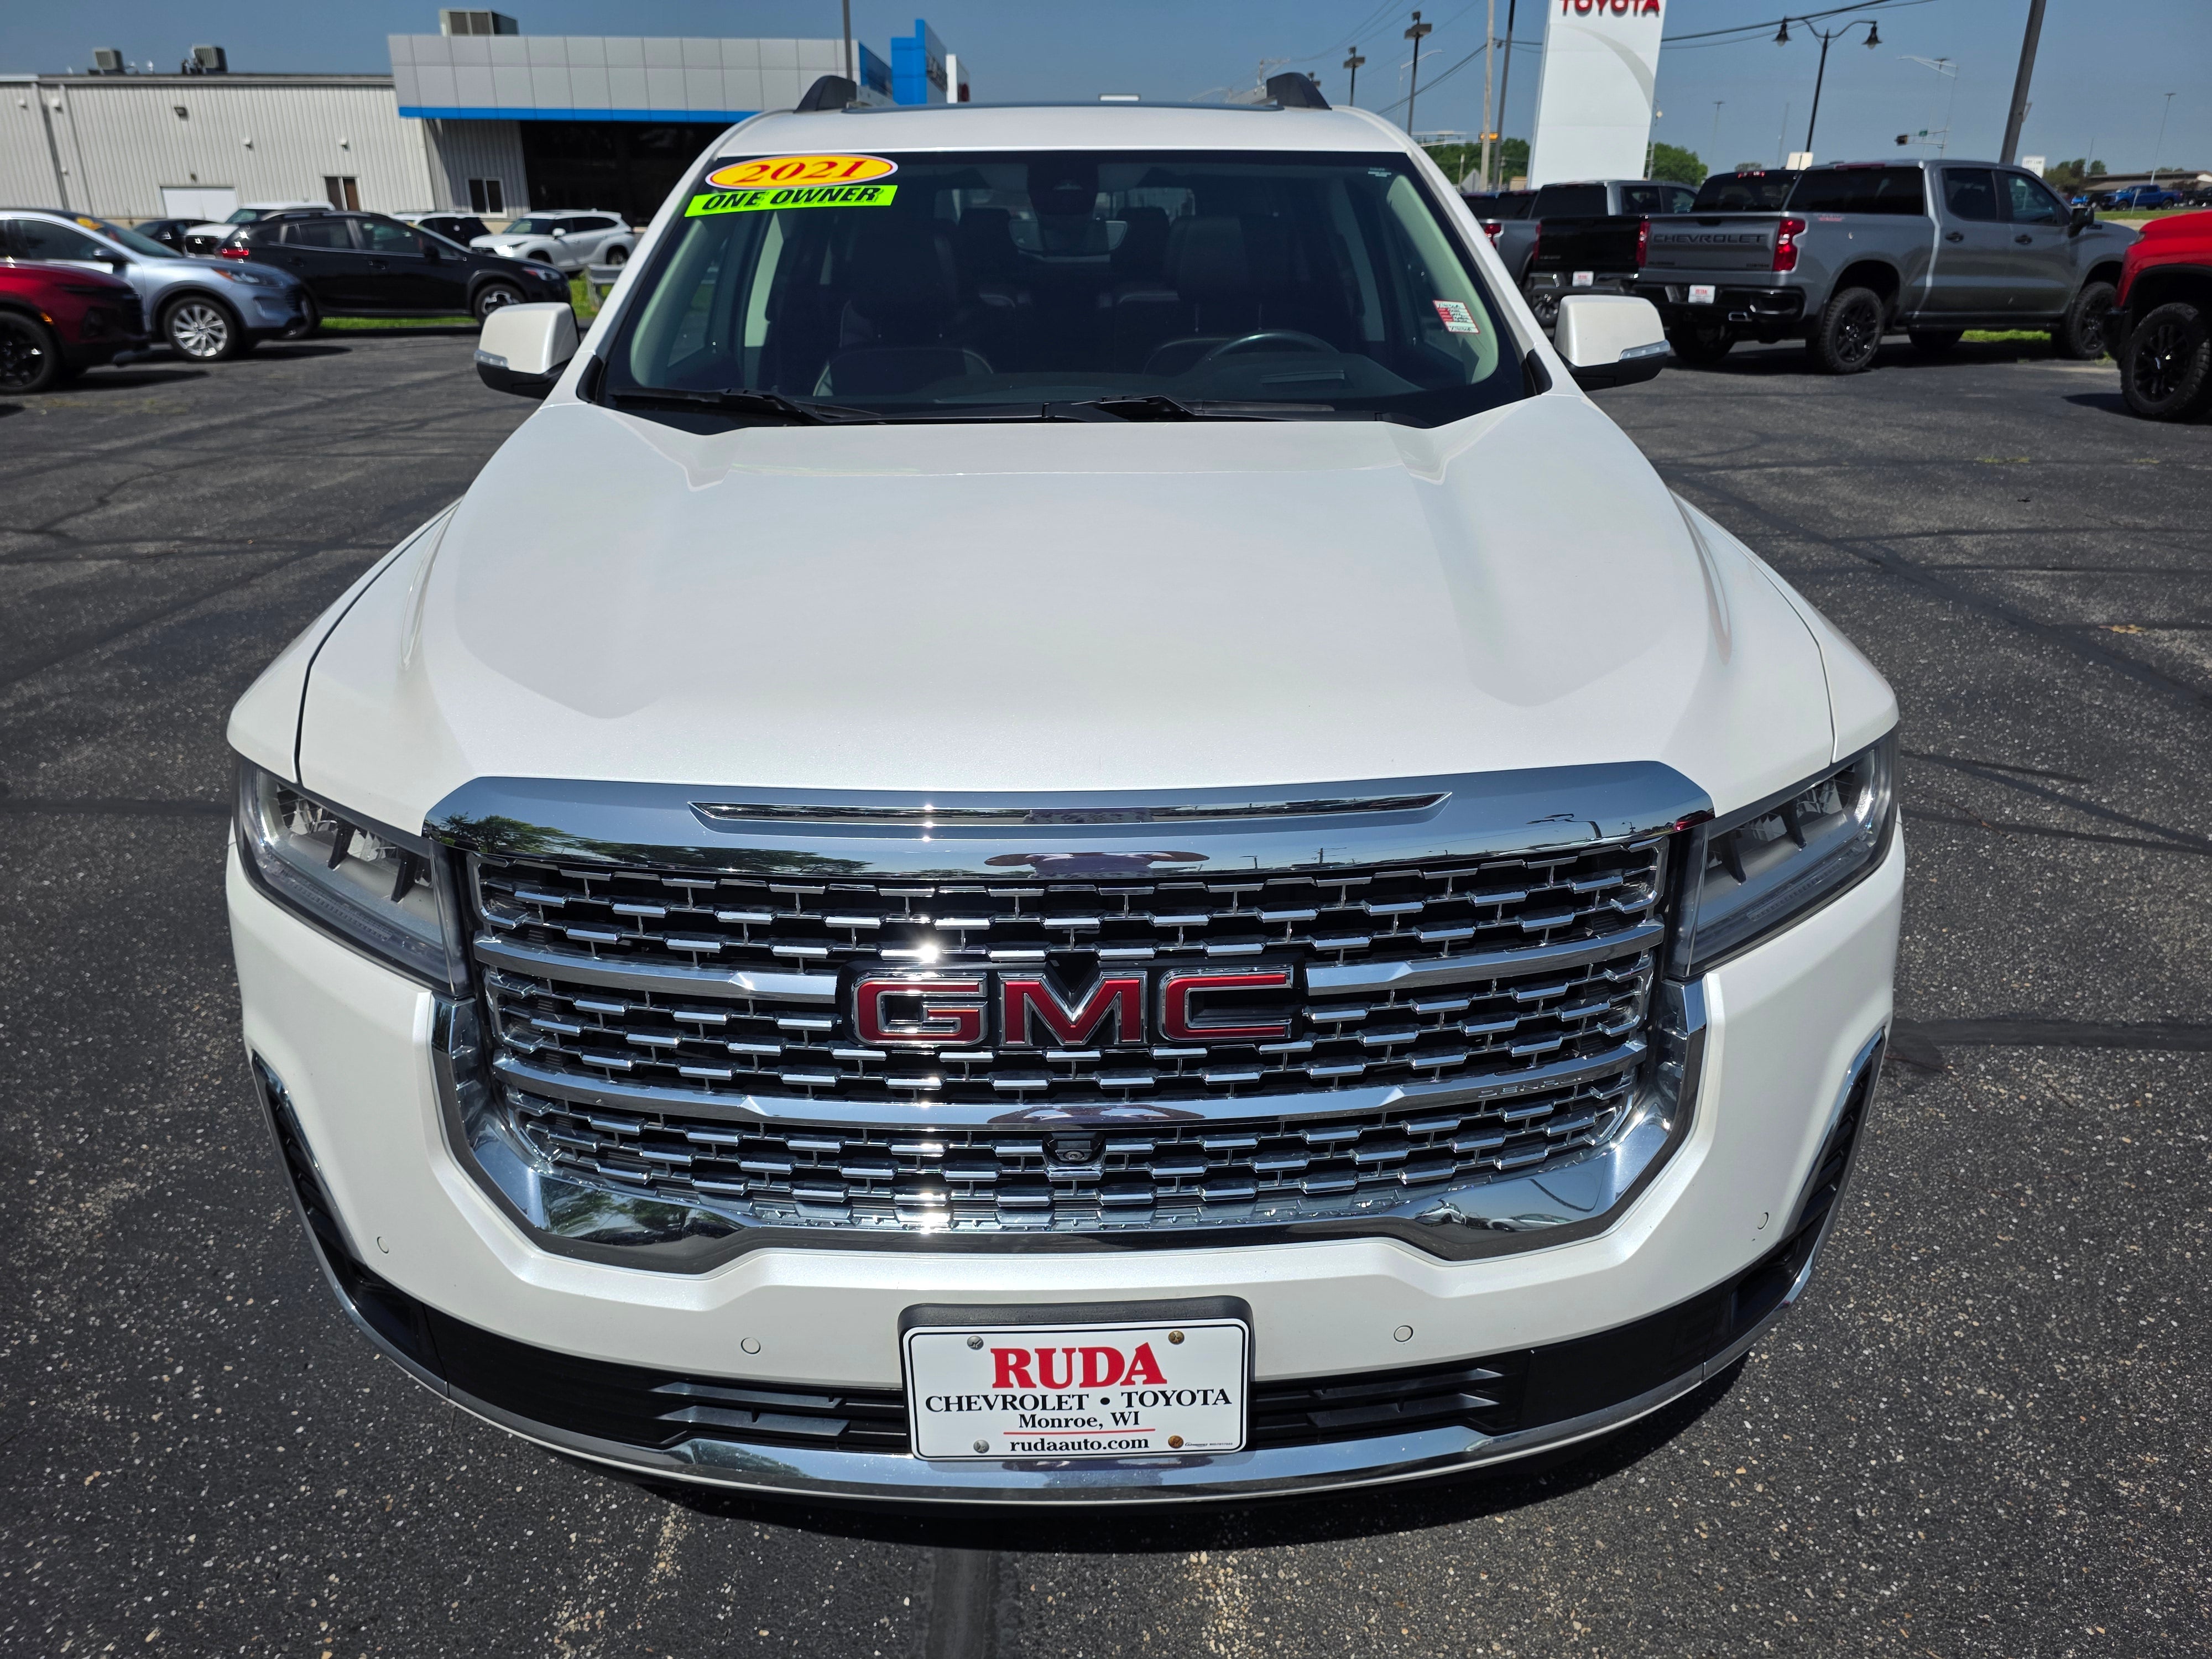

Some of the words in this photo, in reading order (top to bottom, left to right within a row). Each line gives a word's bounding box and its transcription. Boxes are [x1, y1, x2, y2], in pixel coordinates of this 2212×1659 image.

[1559, 0, 1660, 13] TOYOTA
[732, 160, 868, 184] 2021
[702, 191, 768, 211] ONE
[770, 187, 883, 205] OWNER
[1653, 234, 1766, 243] CHEVROLET
[852, 964, 1292, 1046] GMC
[990, 1342, 1167, 1390] RUDA
[925, 1394, 1090, 1413] CHEVROLET
[1121, 1389, 1233, 1408] TOYOTA
[1019, 1414, 1104, 1430] Monroe,
[1110, 1411, 1140, 1426] WI
[1010, 1438, 1150, 1452] rudaauto.com
